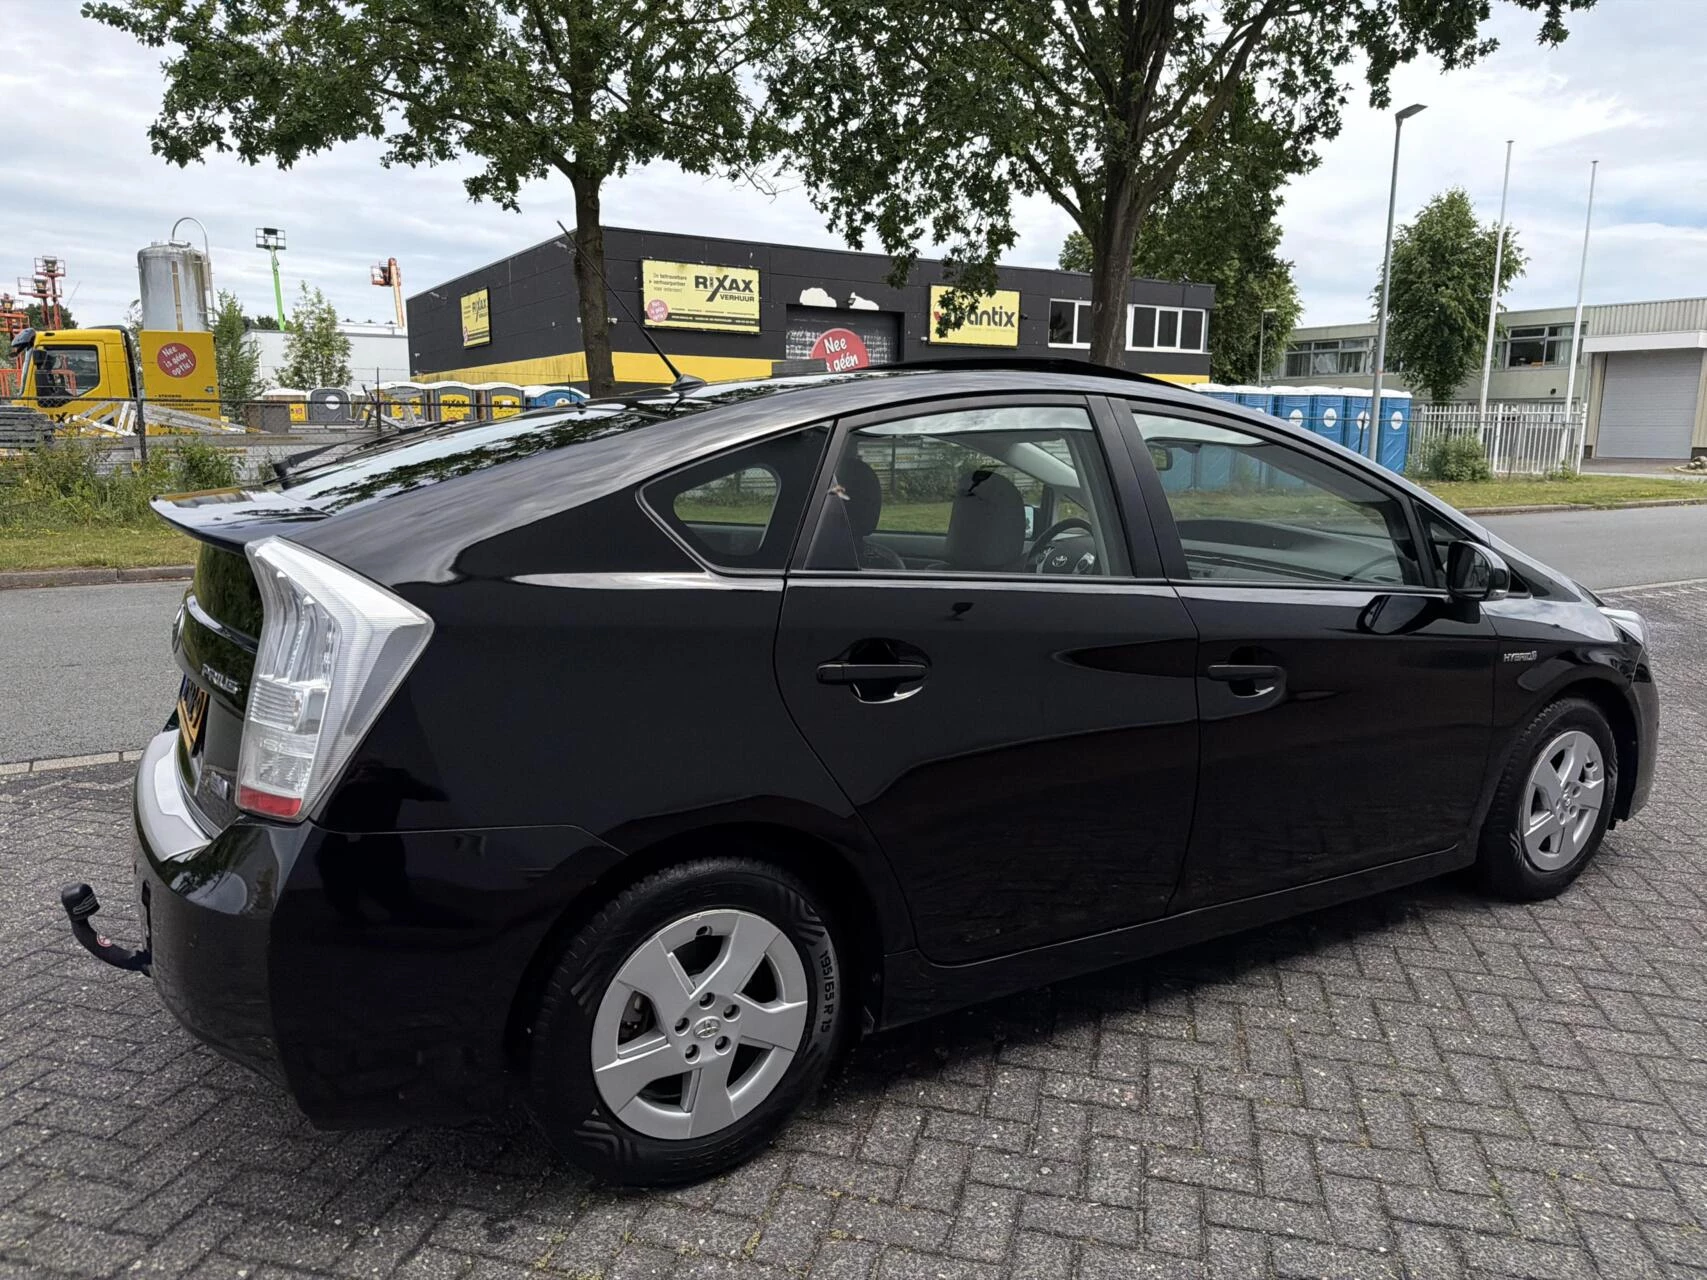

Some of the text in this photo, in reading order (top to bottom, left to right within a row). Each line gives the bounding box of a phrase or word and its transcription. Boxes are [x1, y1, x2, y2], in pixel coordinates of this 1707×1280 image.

[720, 294, 754, 302] VERHUUR
[957, 305, 1015, 328] antix
[161, 346, 178, 357] Nee
[824, 337, 847, 354] Nee
[819, 950, 835, 1001] 195/65
[824, 1004, 834, 1015] R
